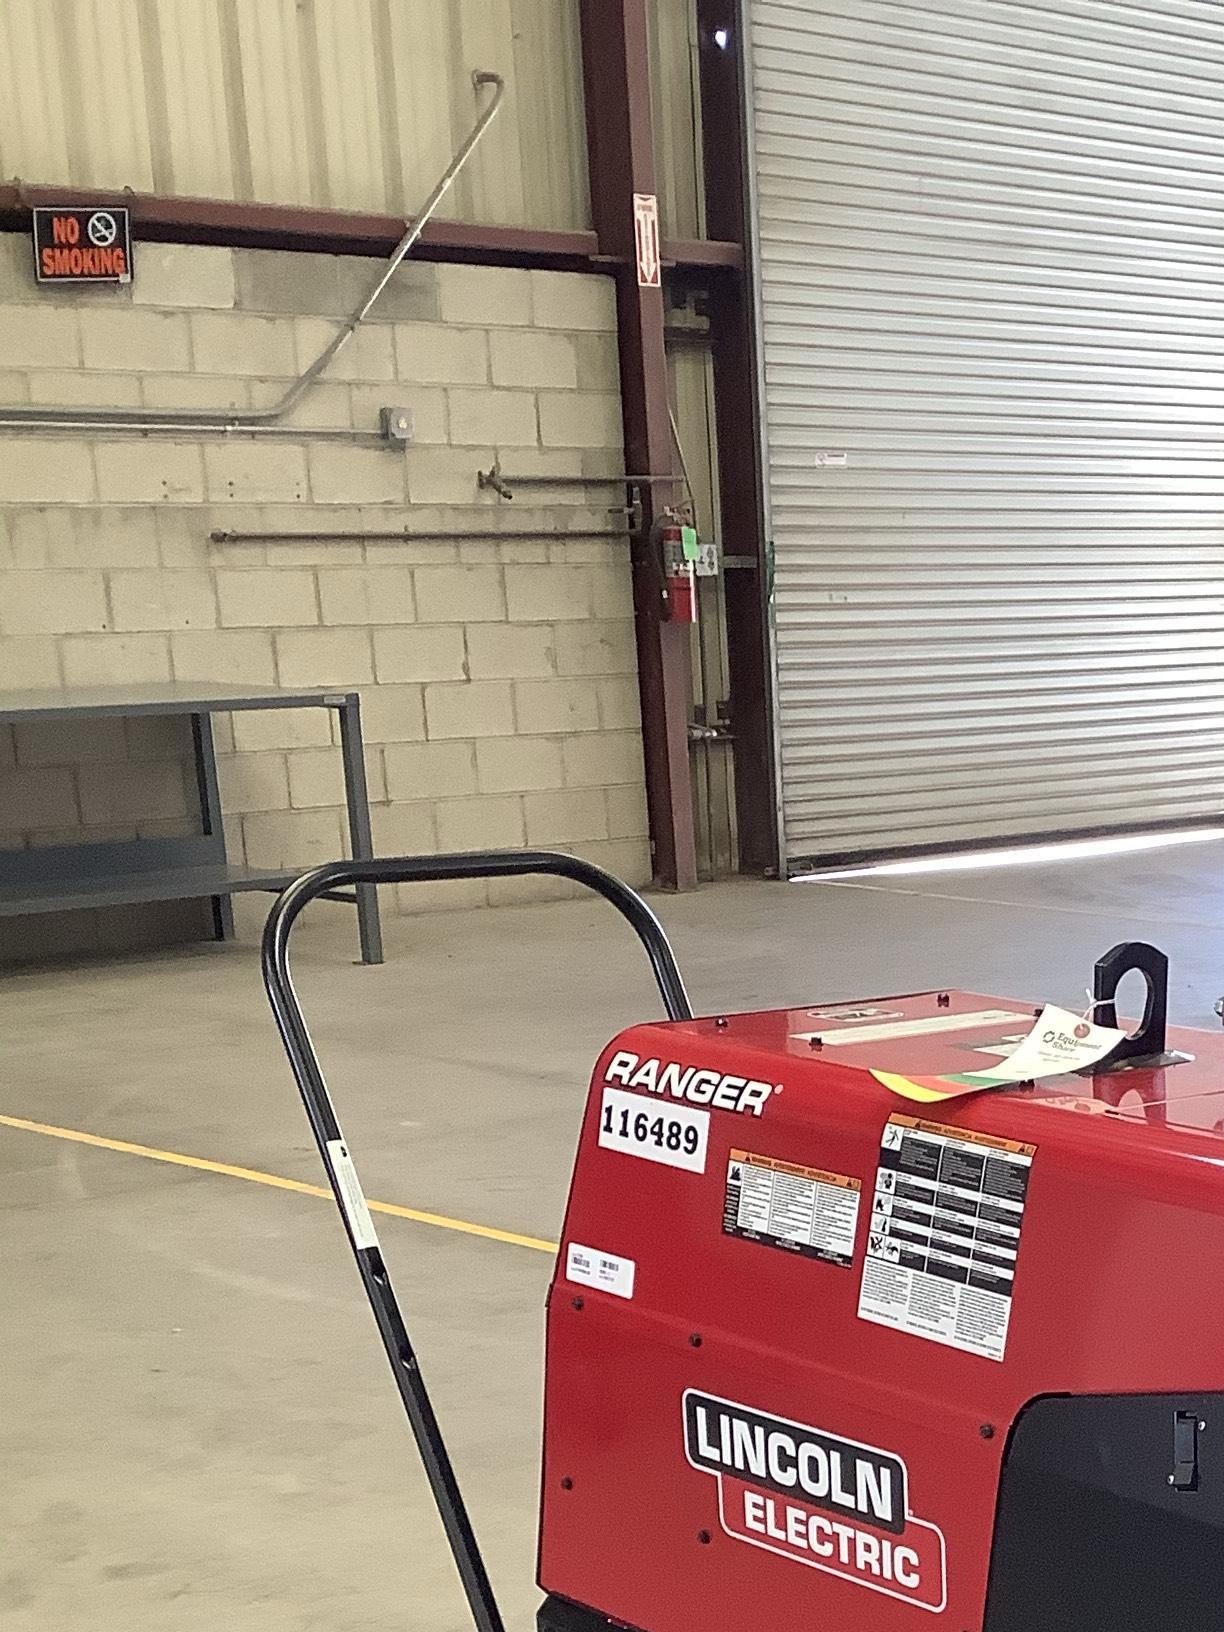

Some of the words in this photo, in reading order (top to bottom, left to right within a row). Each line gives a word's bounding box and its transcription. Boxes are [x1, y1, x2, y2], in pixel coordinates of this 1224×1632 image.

[53, 216, 80, 244] NO
[42, 247, 126, 275] SMOKING
[1056, 1032, 1102, 1050] Equit
[604, 1051, 773, 1116] RANGER
[602, 1104, 699, 1155] 116489
[695, 1405, 893, 1522] LINCOLN
[743, 1490, 920, 1589] ELECTRIC
